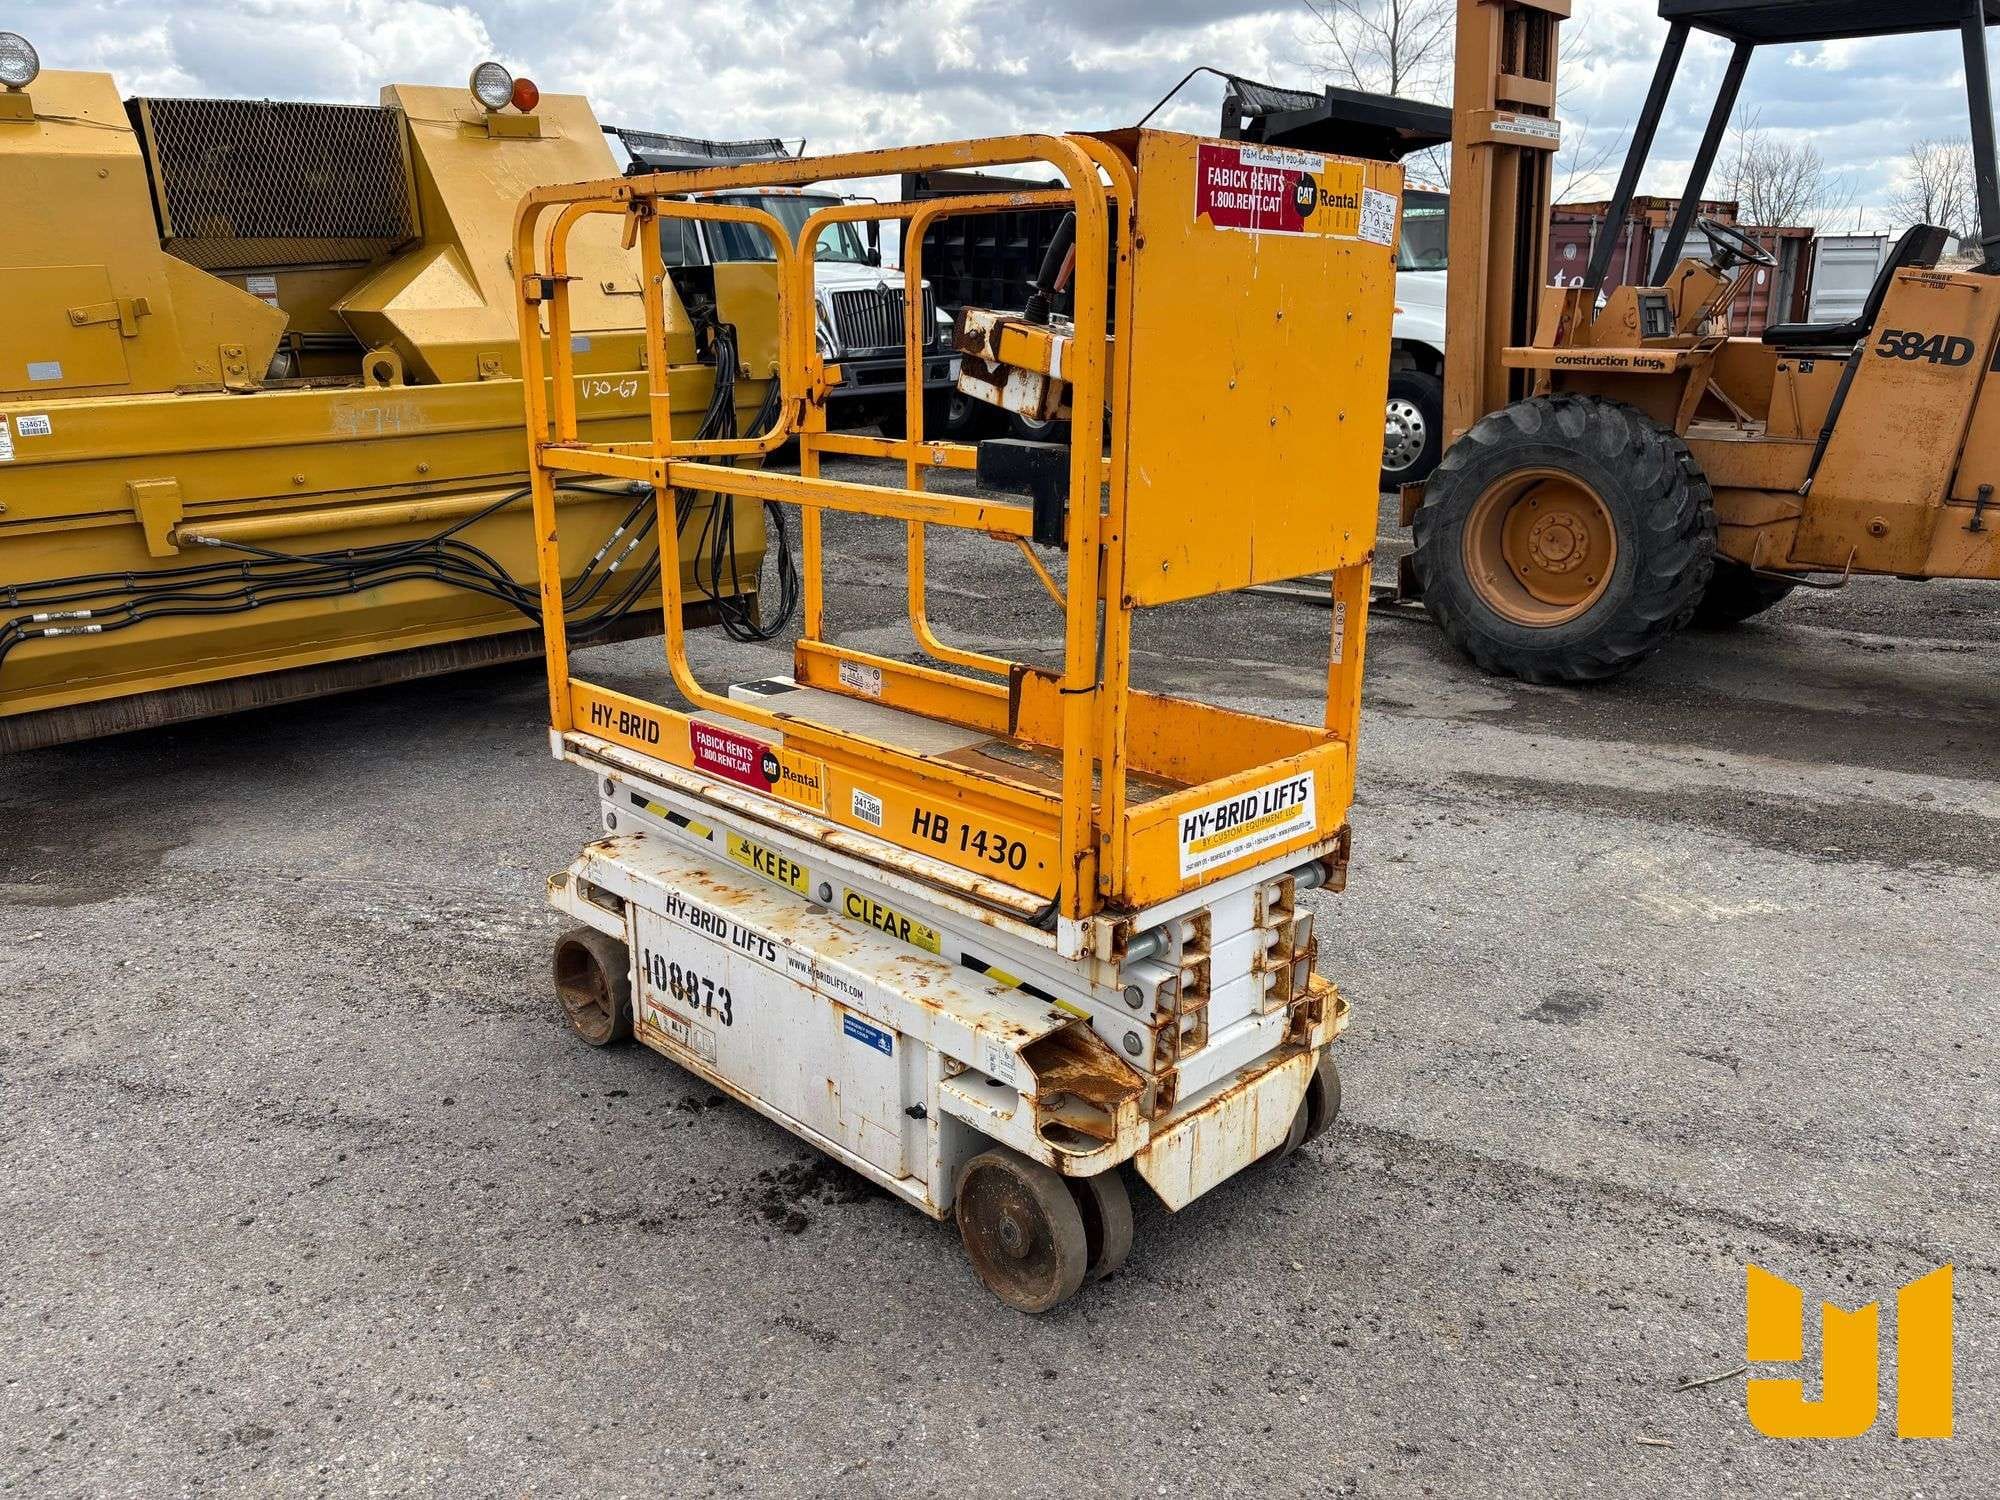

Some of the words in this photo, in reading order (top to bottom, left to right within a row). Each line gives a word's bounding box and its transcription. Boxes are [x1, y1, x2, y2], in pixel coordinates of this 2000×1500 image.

[1207, 166, 1248, 188] FABICK
[1250, 171, 1285, 192] RENTS
[1209, 190, 1281, 213] 1.800.RENT.CAT
[1297, 186, 1314, 206] CAT
[1320, 189, 1359, 210] Rental
[1555, 355, 1628, 367] construction
[1875, 328, 1975, 367] 584D
[19, 419, 48, 429] 534675
[591, 701, 660, 745] HY-BRID
[696, 731, 725, 752] FABICK
[726, 742, 753, 761] RENTS
[699, 747, 752, 774] 1.800.RENT.CAT
[763, 759, 778, 775] CAT
[781, 765, 820, 789] Rental
[854, 795, 881, 816] 341388
[1182, 795, 1258, 844] HY-BRID
[1263, 778, 1308, 816] LIFTS
[911, 807, 950, 844] HB
[960, 824, 1028, 871] 1430
[1202, 837, 1211, 847] BY
[1213, 826, 1243, 844] CUSTOM
[1245, 811, 1283, 832] EQUIPMENT
[1285, 806, 1297, 819] LLC
[753, 845, 801, 887] KEEP
[846, 892, 911, 943] CLEAR
[666, 895, 728, 939] HY-BRID
[732, 926, 777, 963] LIFTS
[788, 957, 864, 1001] WWW.HYBRIDLIFTS.COM
[644, 948, 733, 1027] 108873
